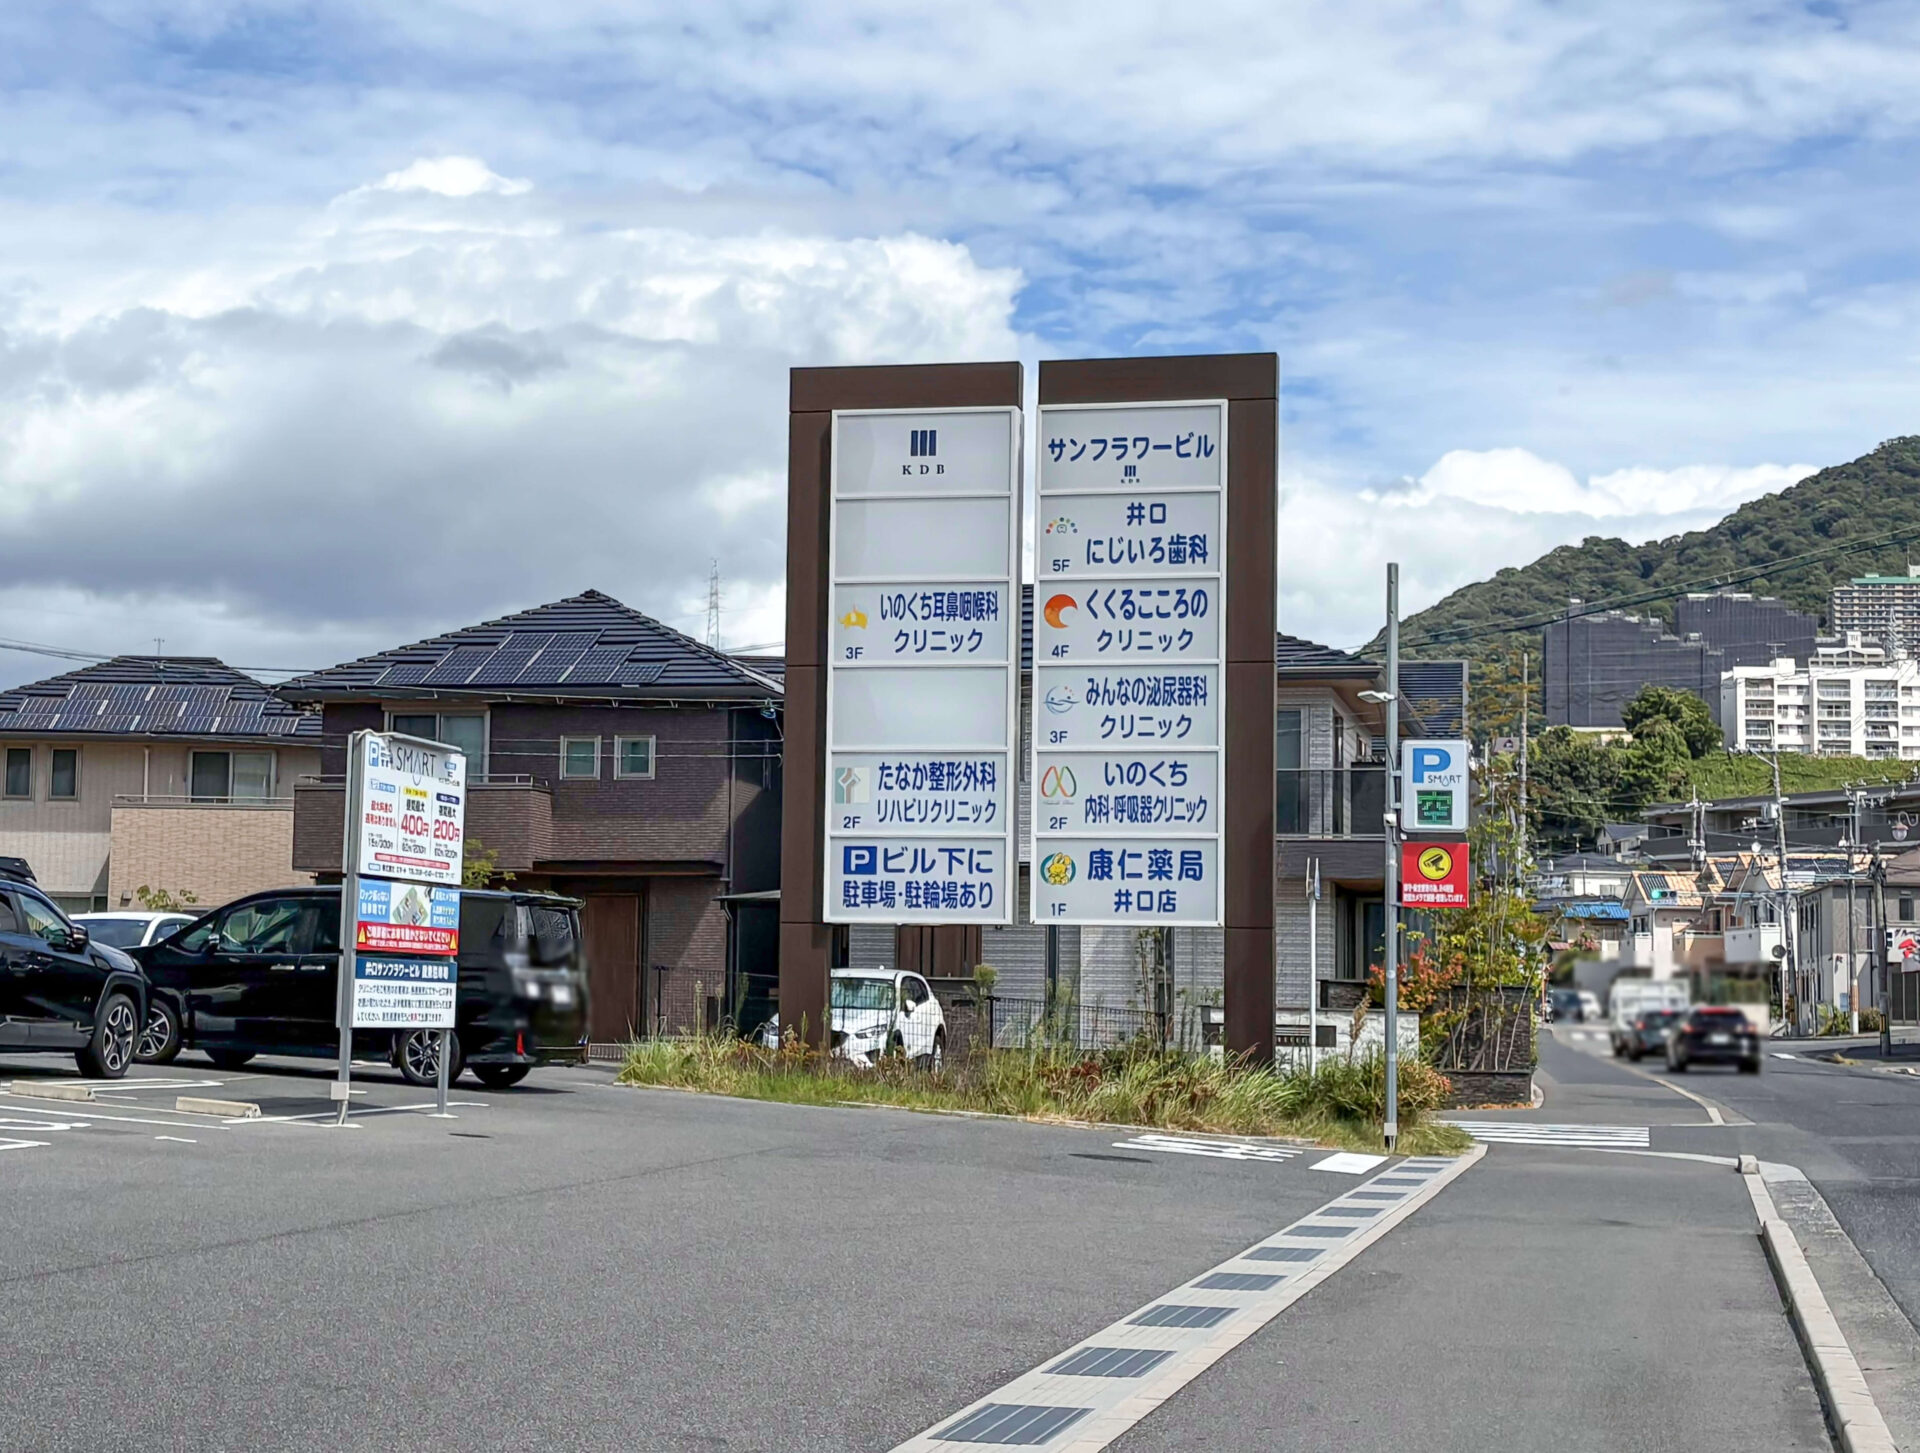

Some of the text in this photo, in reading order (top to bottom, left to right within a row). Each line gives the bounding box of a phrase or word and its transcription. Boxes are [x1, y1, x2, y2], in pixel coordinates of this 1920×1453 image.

[1048, 431, 1215, 462] サンフラワービル
[901, 464, 946, 475] KDB
[1126, 502, 1167, 526] 井口
[1086, 533, 1209, 565] にじいろ歯科
[1052, 559, 1071, 572] 5F
[880, 590, 999, 622] いのくち耳鼻咽喉科
[1086, 588, 1208, 620] くくるこころの
[894, 628, 983, 653] クリニック
[1051, 645, 1070, 657] 4F
[1097, 628, 1193, 652] クリニック
[845, 647, 864, 660] 3F
[1086, 675, 1208, 706] みんなの泌尿器科
[1050, 730, 1068, 743] 3F
[1100, 714, 1192, 739] クリニック
[396, 746, 437, 785] SMART
[878, 761, 997, 792] たなか整形外科
[1104, 760, 1188, 787] いのくち
[1412, 747, 1452, 784] P
[1427, 774, 1463, 787] SMART
[877, 798, 997, 823] リハビリクリニック
[1084, 794, 1207, 824] 内科・呼吸器クリニック
[401, 813, 429, 837] 400円
[433, 818, 460, 843] 200円
[843, 816, 862, 829] 2F
[1049, 816, 1068, 830] 2F
[849, 846, 993, 876] P ビル下に
[1087, 848, 1204, 881] 康仁薬局
[1051, 903, 1067, 916] 1F
[1114, 889, 1177, 913] 井口店
